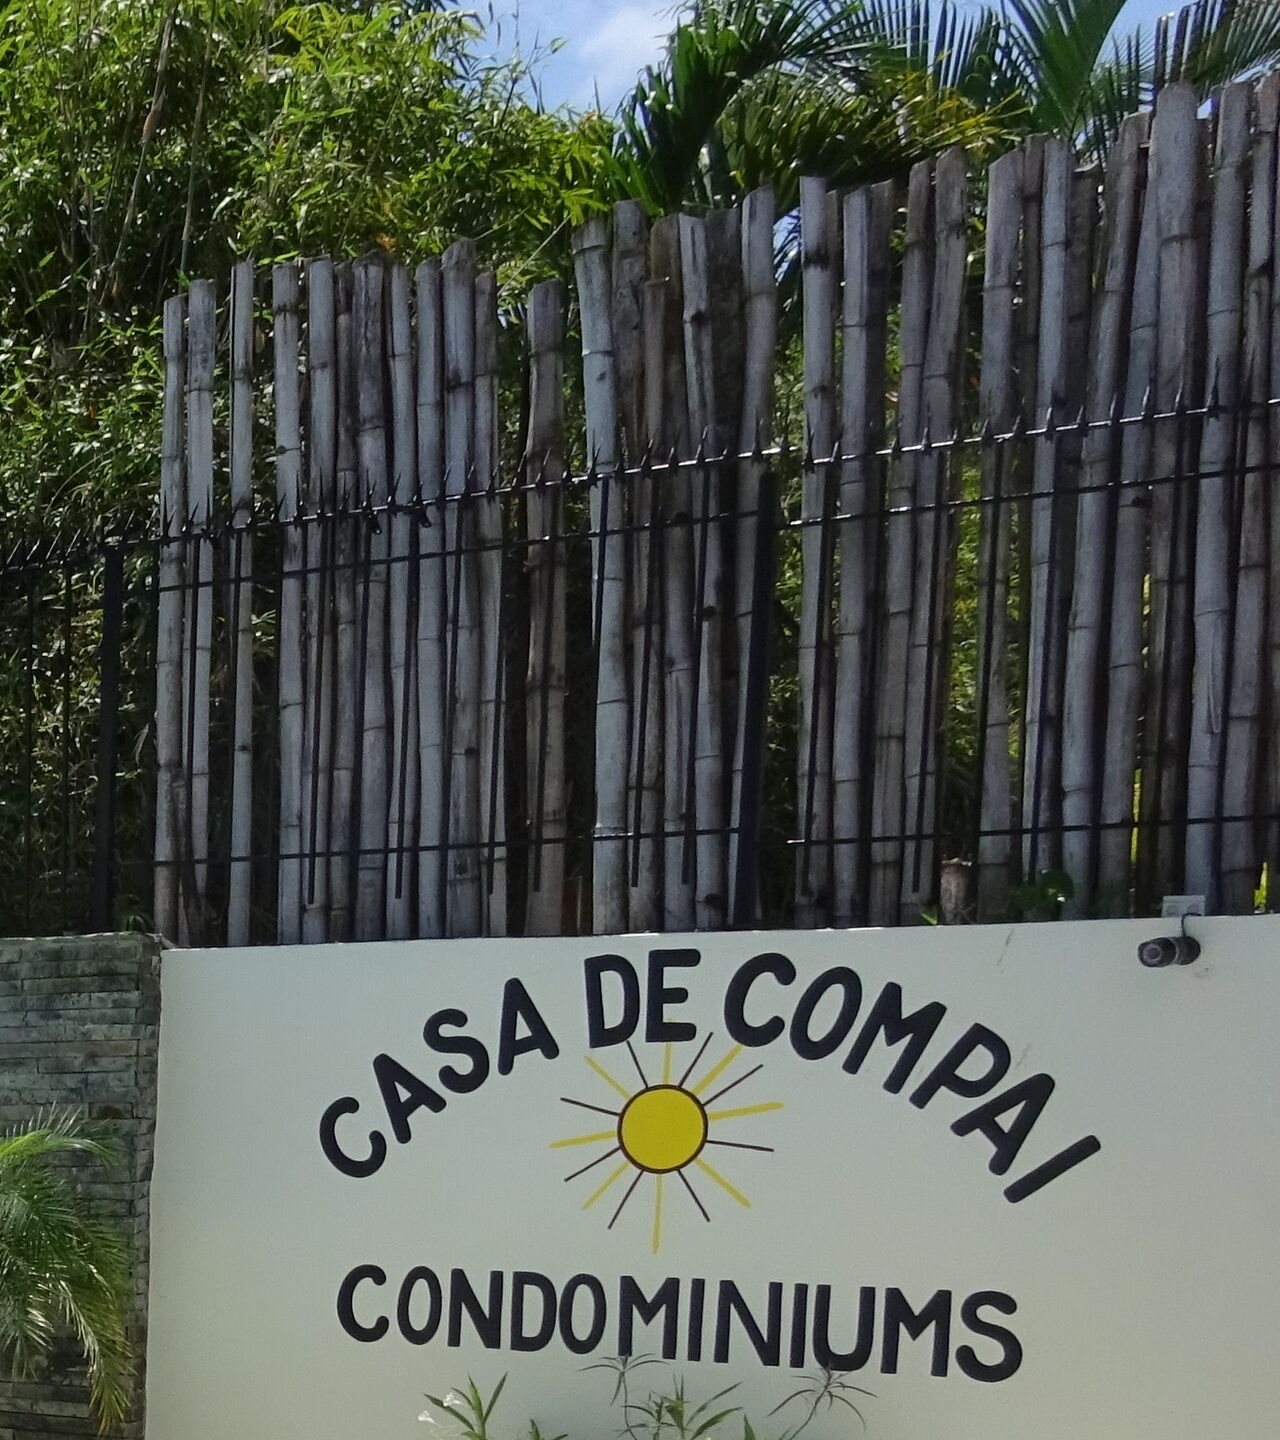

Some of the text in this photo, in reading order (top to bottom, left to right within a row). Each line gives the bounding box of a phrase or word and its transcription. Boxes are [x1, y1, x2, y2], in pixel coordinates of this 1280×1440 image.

[319, 948, 1101, 1203] CASA DE COMPAI
[336, 1264, 1022, 1382] CONDOMINIUMS
